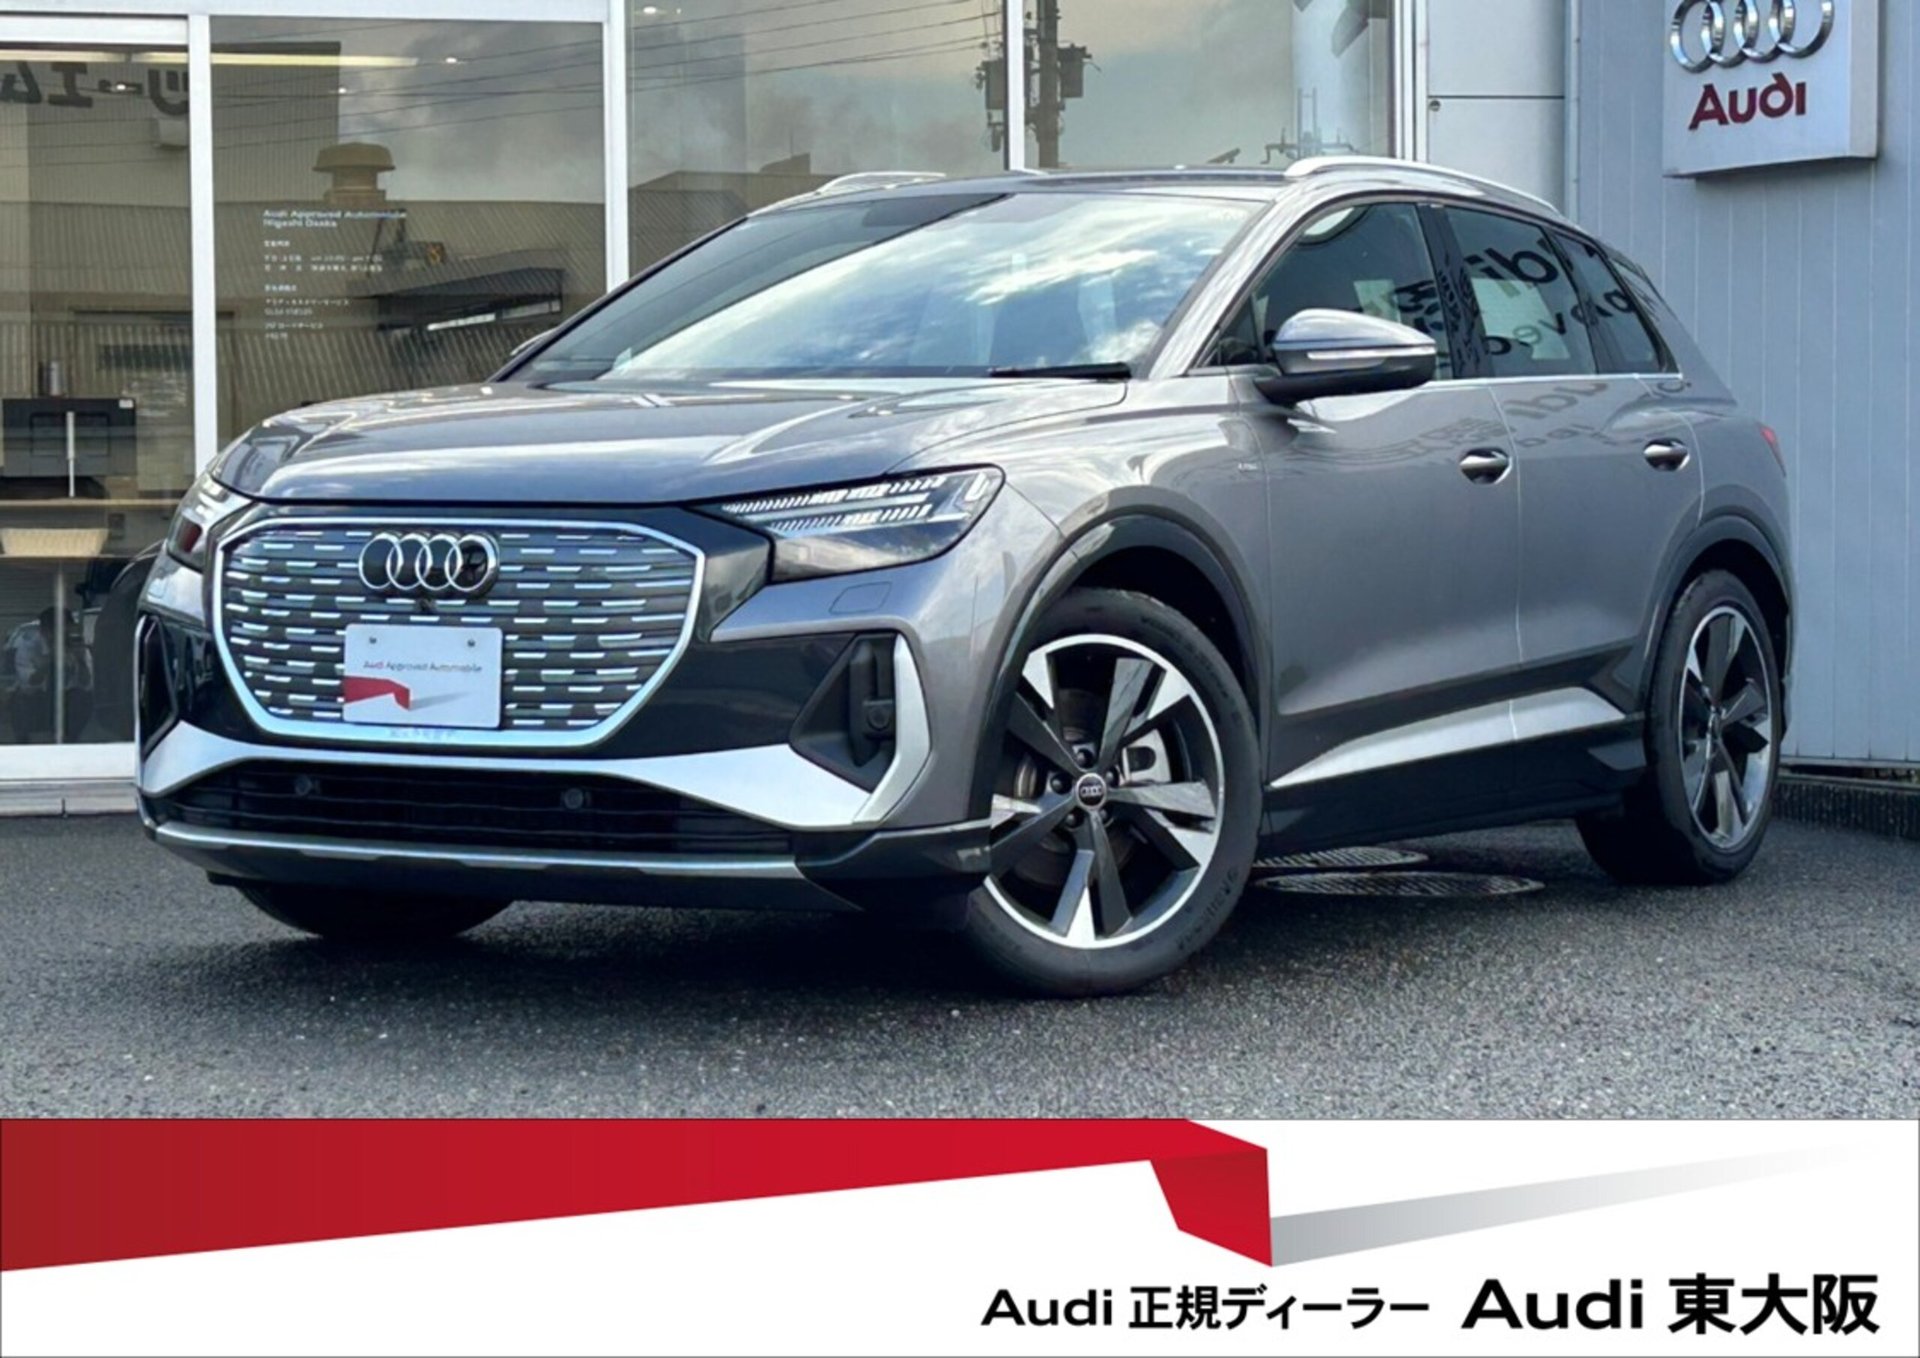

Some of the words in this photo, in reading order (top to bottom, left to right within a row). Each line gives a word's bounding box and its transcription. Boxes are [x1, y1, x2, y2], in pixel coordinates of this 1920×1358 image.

[1687, 72, 1807, 131] Audi
[363, 660, 384, 670] Audi
[385, 661, 428, 672] Approved
[430, 662, 482, 672] Automobile
